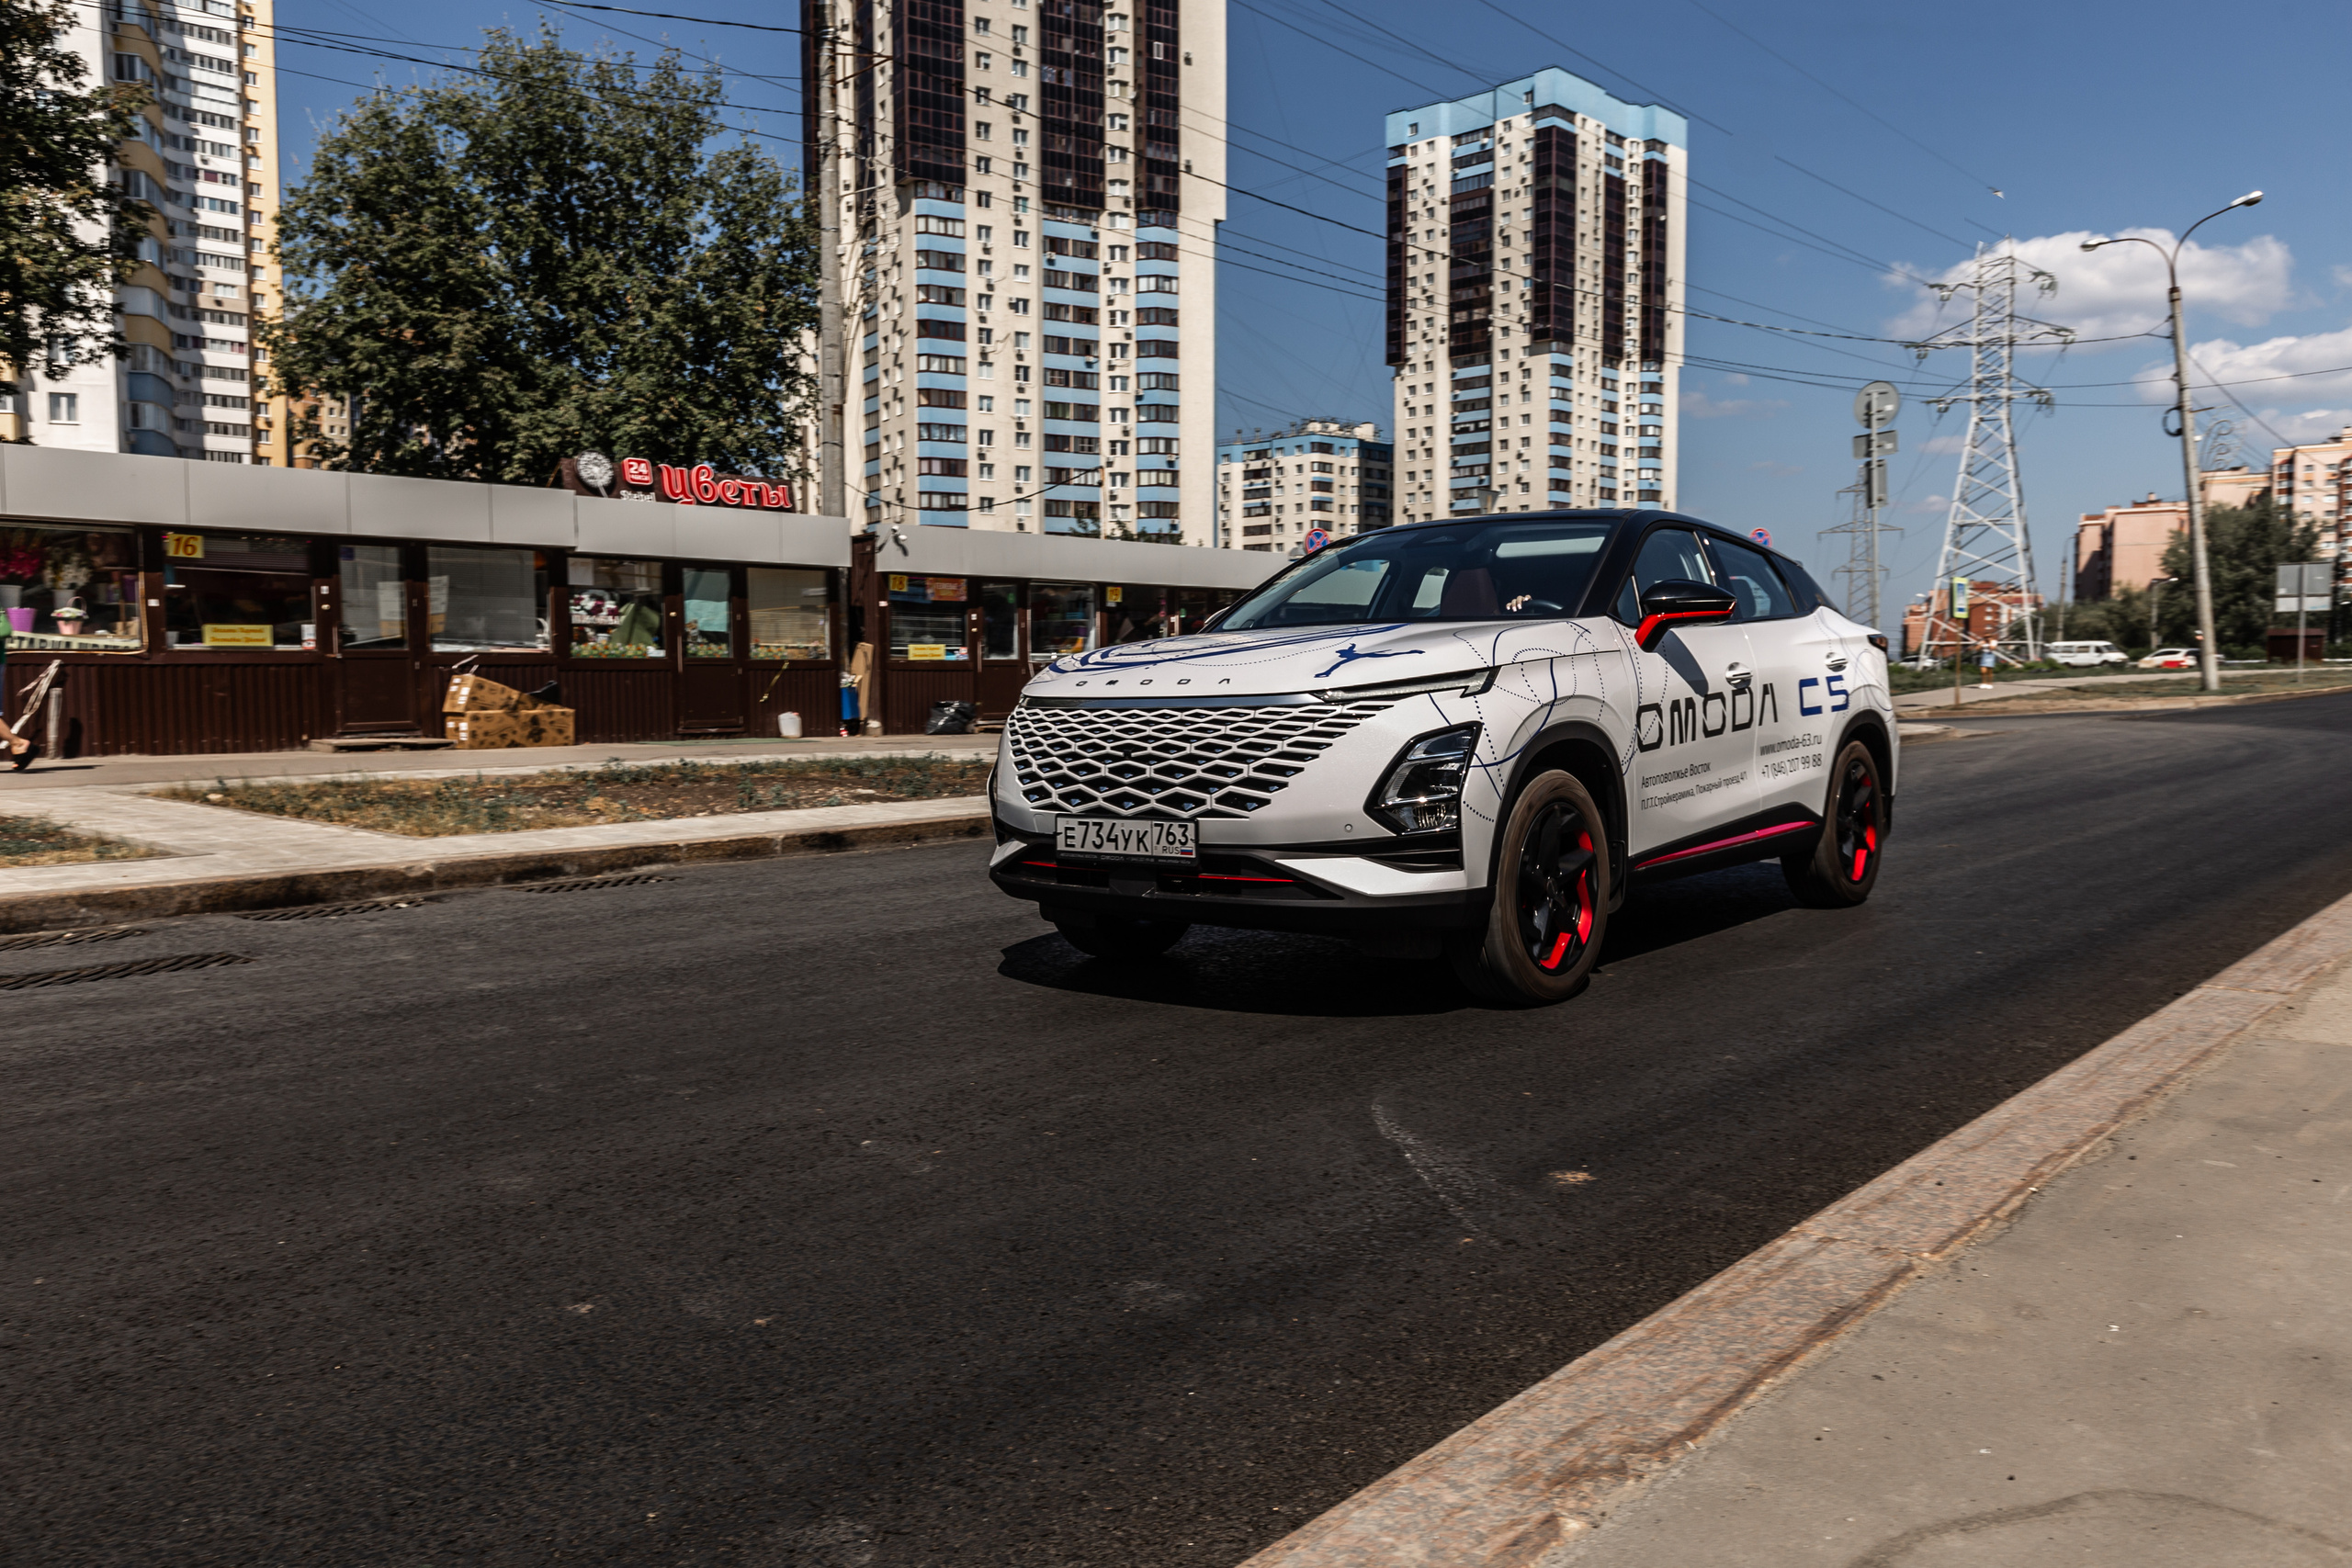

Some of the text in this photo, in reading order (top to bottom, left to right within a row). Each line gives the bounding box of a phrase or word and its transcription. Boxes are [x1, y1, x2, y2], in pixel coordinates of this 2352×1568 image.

[628, 461, 649, 475] 24
[172, 536, 198, 557] 16
[1076, 678, 1231, 687] OMODA
[1636, 675, 1850, 753] OMODA C5
[1760, 733, 1823, 756] www.omoda-63.ru
[1641, 761, 1712, 789] Автоповолжье Восток
[1761, 753, 1822, 779] +7 (846) 207 99 88
[1696, 778, 1723, 795] Пожарный
[1162, 845, 1181, 855] RUS
